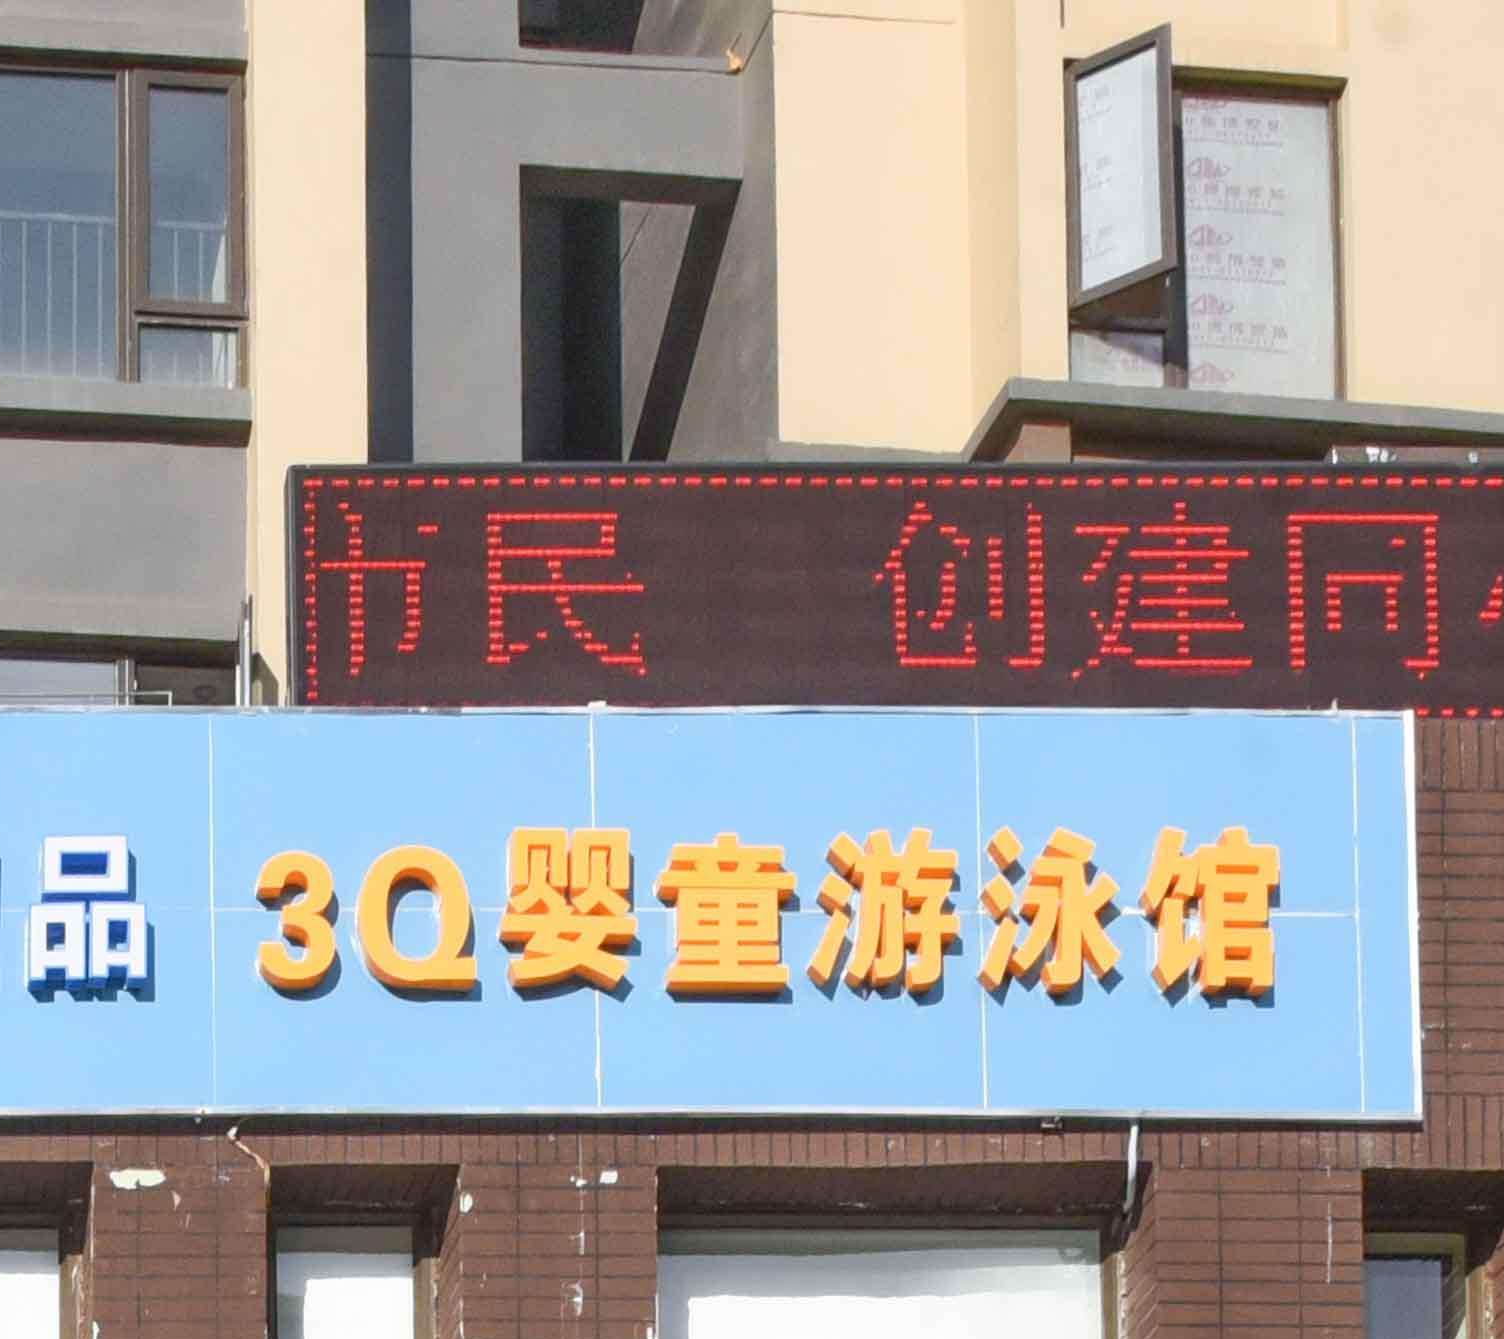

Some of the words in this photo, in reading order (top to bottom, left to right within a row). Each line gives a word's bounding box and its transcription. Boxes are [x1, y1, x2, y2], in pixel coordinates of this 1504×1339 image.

[254, 826, 1286, 1000] 3Q婴童游泳馆
